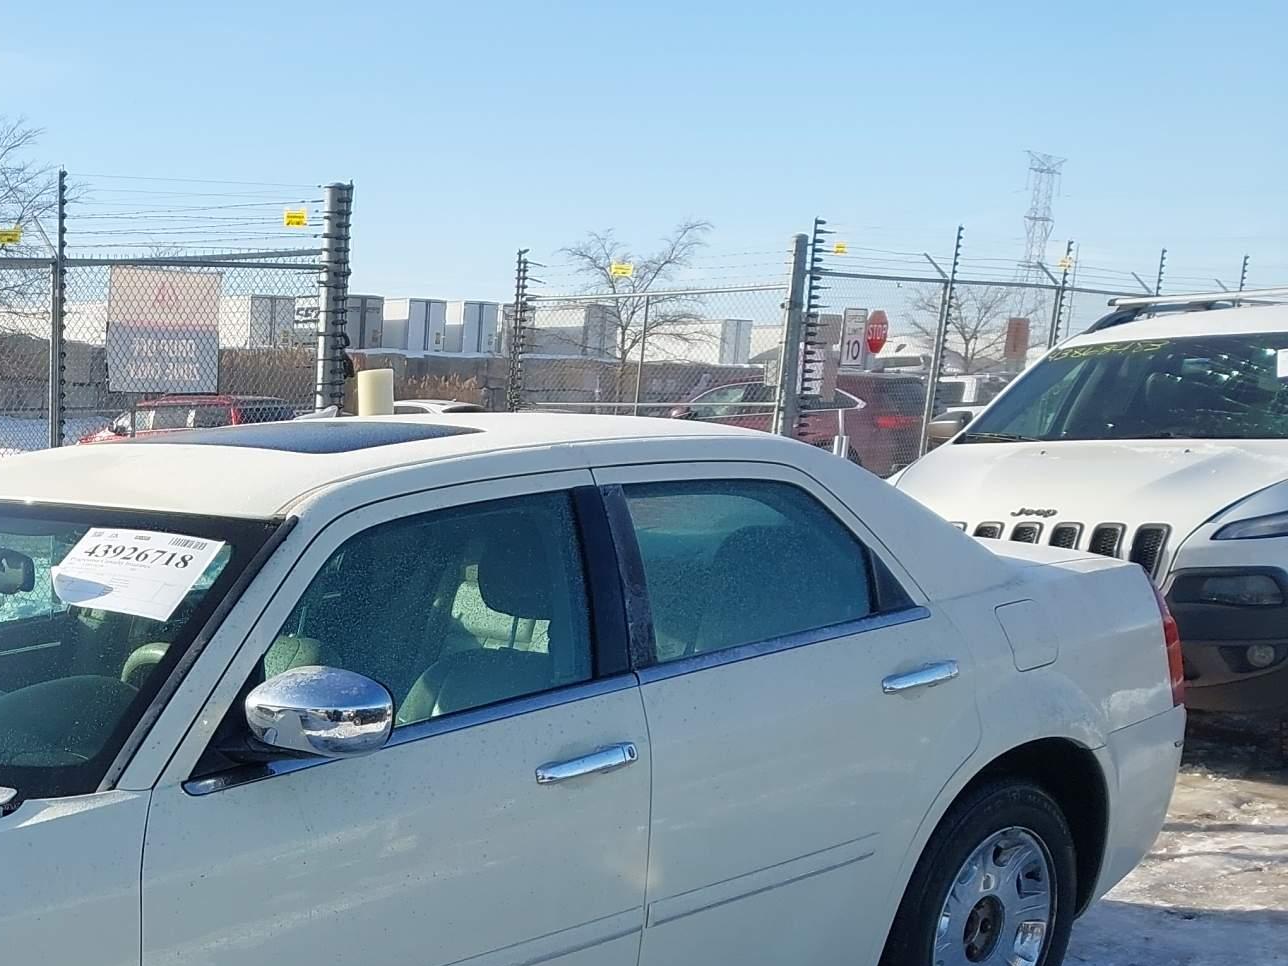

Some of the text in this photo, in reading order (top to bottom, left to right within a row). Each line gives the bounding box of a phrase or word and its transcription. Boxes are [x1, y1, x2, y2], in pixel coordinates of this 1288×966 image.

[867, 323, 887, 340] STOP
[846, 340, 860, 361] 10
[1010, 506, 1058, 518] Jeep
[84, 543, 194, 569] 43926718
